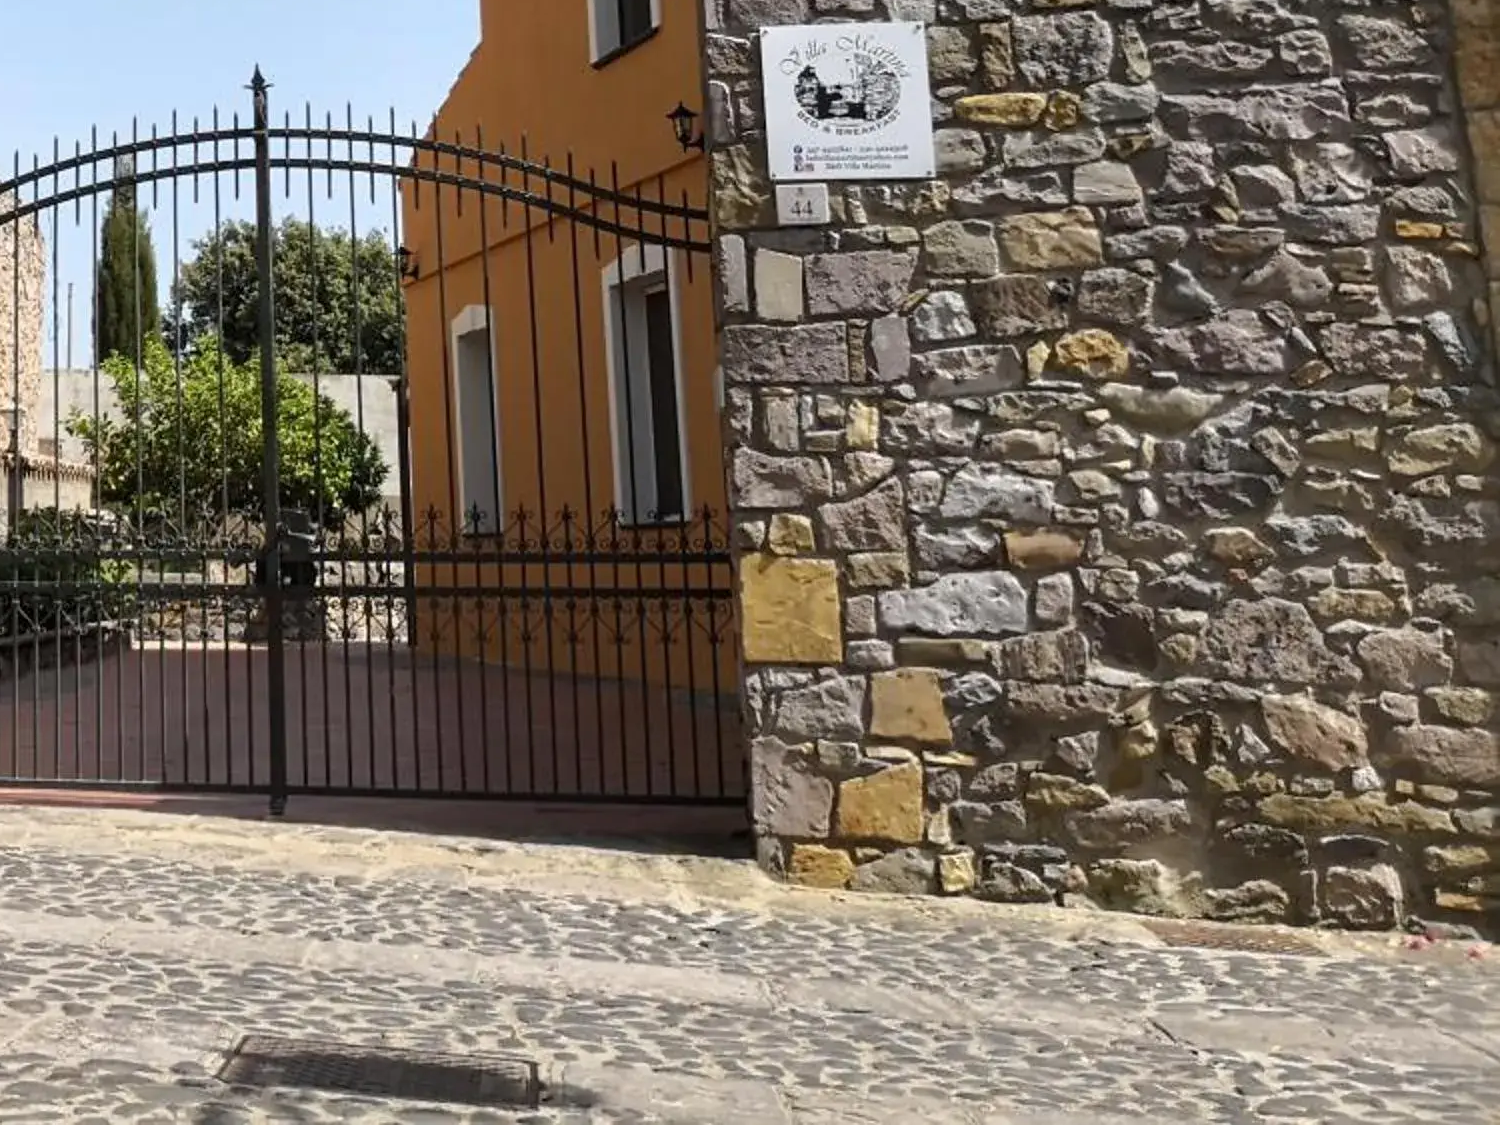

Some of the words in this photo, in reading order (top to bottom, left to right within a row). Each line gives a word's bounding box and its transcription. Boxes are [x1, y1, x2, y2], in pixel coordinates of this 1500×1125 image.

[797, 110, 819, 129] BED
[834, 108, 901, 136] BREAKFAST
[790, 199, 814, 216] 44
